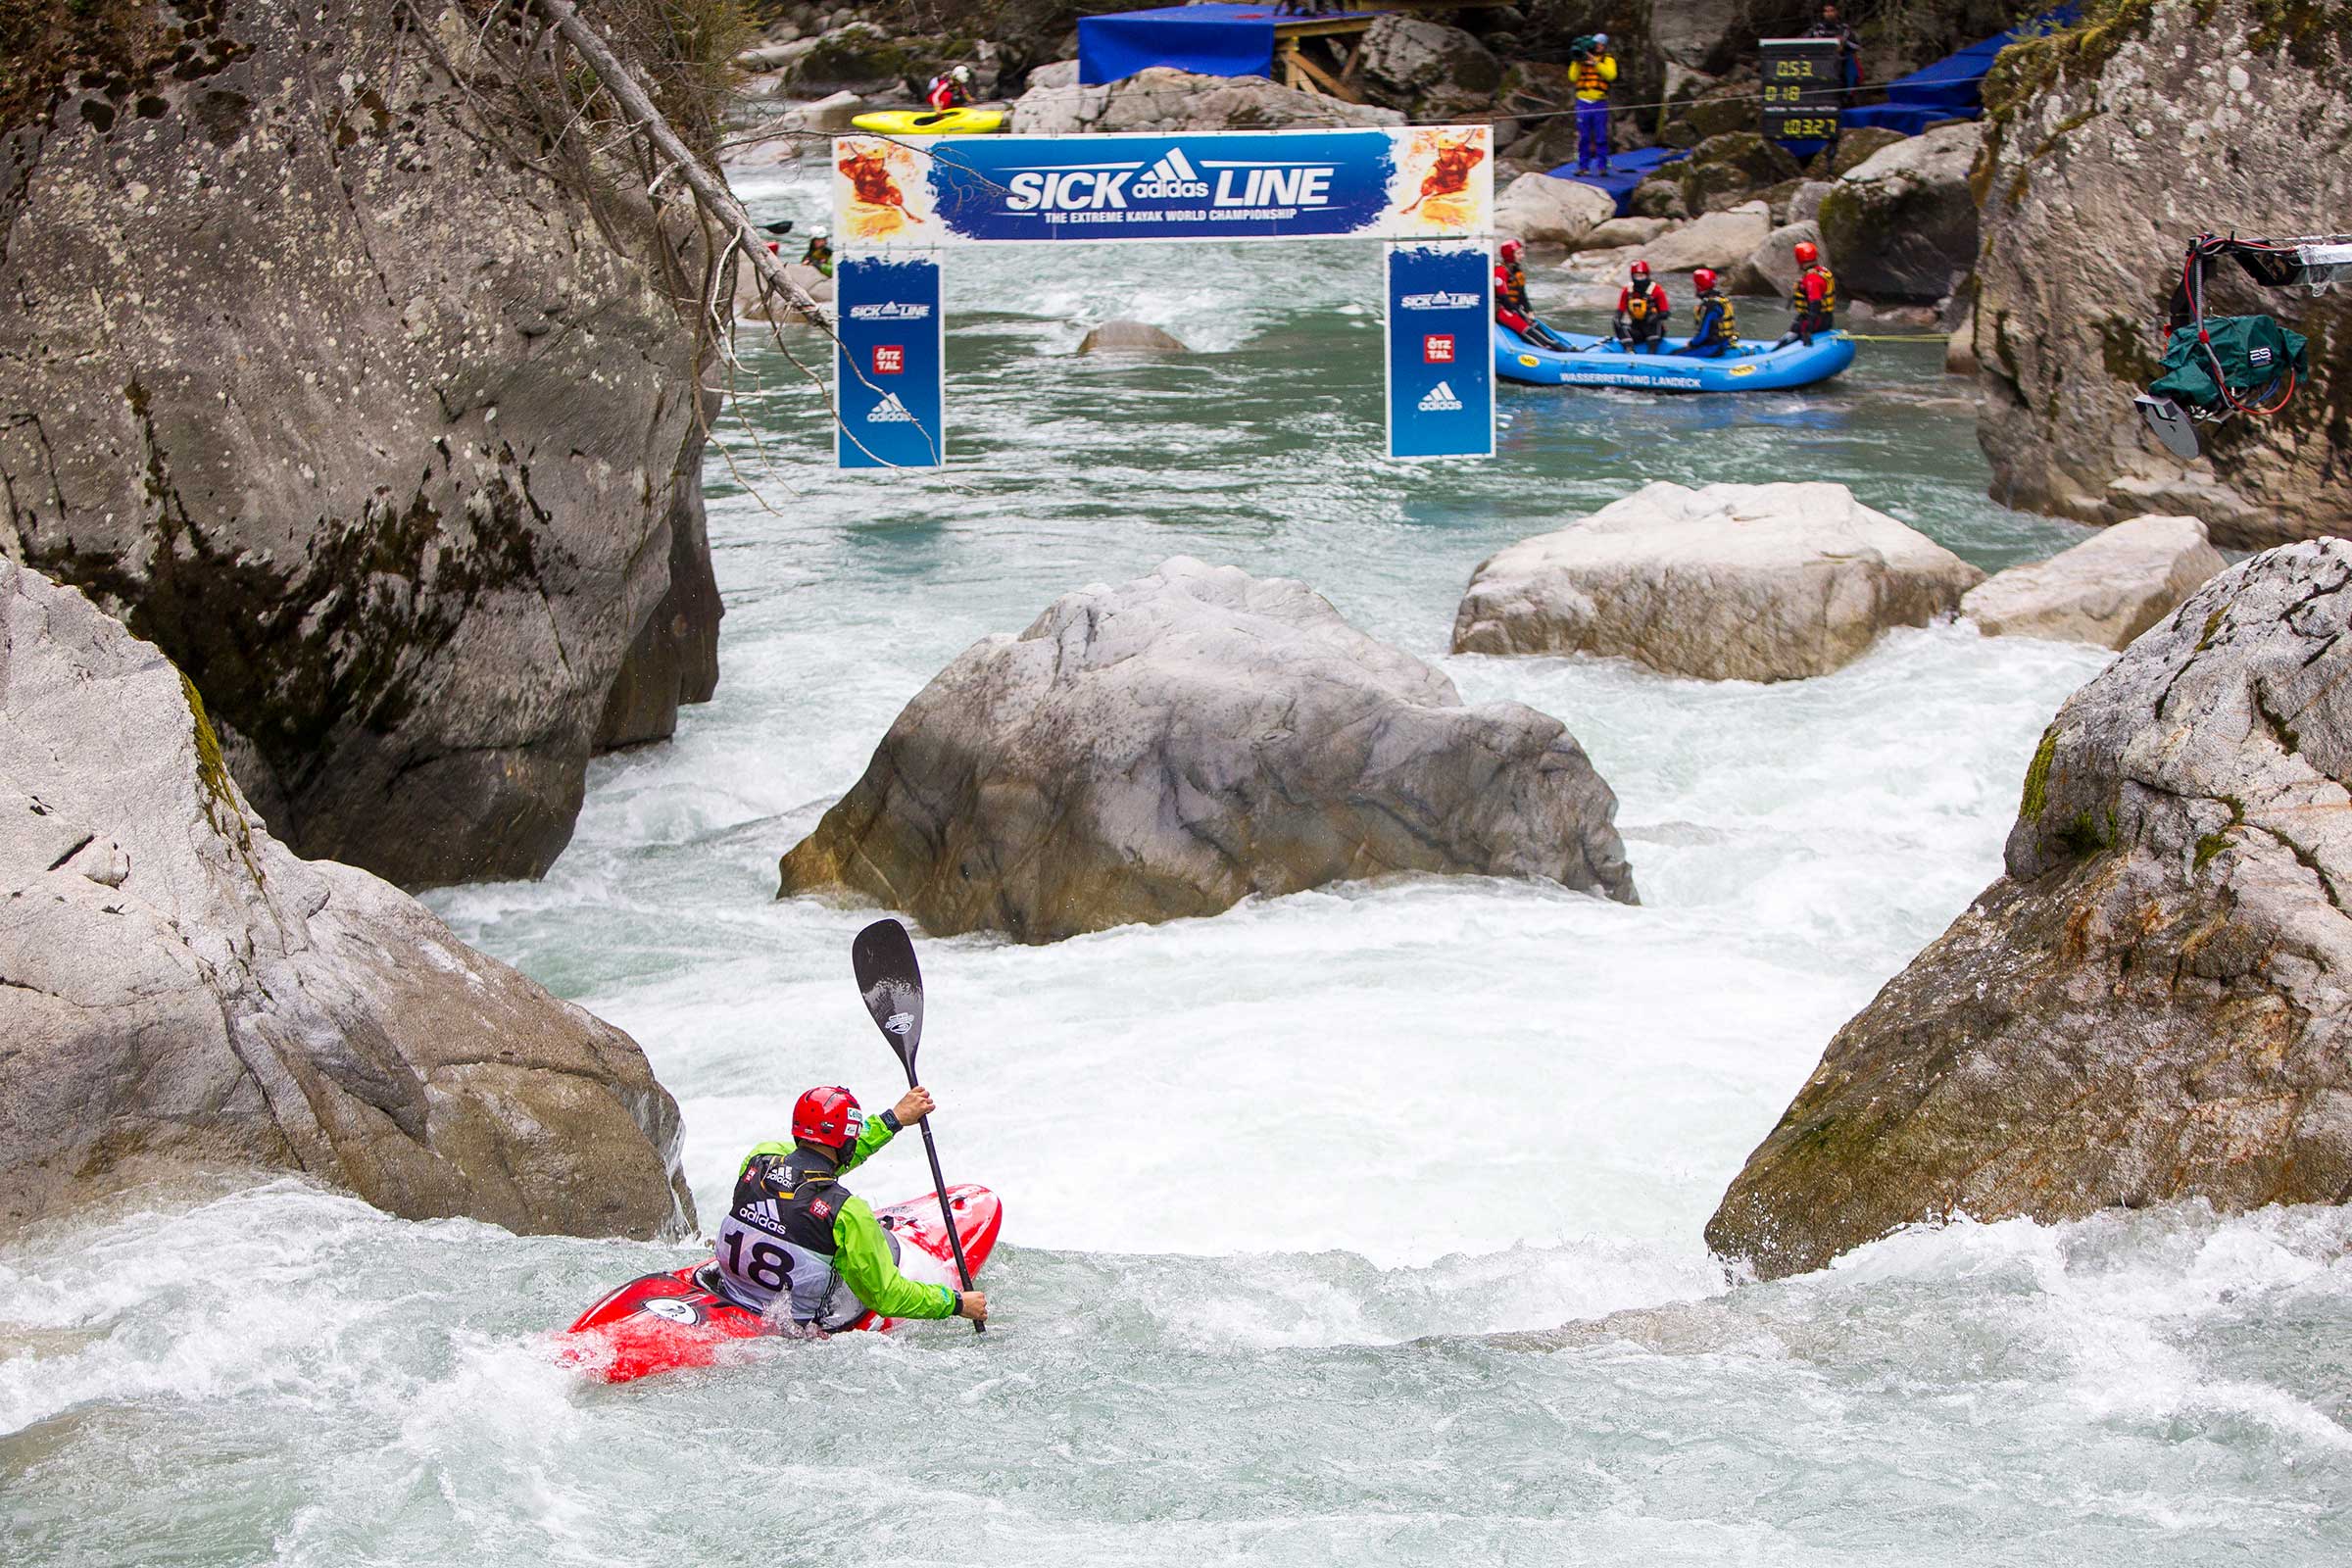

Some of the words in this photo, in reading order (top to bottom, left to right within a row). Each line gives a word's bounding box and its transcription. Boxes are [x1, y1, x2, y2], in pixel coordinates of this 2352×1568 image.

[1005, 172, 1134, 210] SICK
[1132, 178, 1209, 199] adidas
[1213, 168, 1334, 207] LINE
[1045, 213, 1067, 223] THE
[1069, 212, 1123, 223] EXTREME
[1126, 211, 1163, 222] KAYAK
[1165, 210, 1206, 221] WORLD
[1208, 208, 1298, 221] CHAMPIONSHIP
[1400, 296, 1431, 308] SICK
[1450, 295, 1480, 306] LINE
[850, 306, 880, 318] SICK
[901, 305, 930, 317] LINE
[876, 348, 901, 360] ÖTZ
[1428, 350, 1451, 359] TAL
[877, 361, 901, 370] TAL
[1560, 372, 1650, 385] WASSERRETTUNG
[1652, 376, 1701, 388] LANDECK
[1418, 400, 1462, 411] adidas
[739, 1207, 787, 1235] adidas
[724, 1230, 795, 1293] 18
